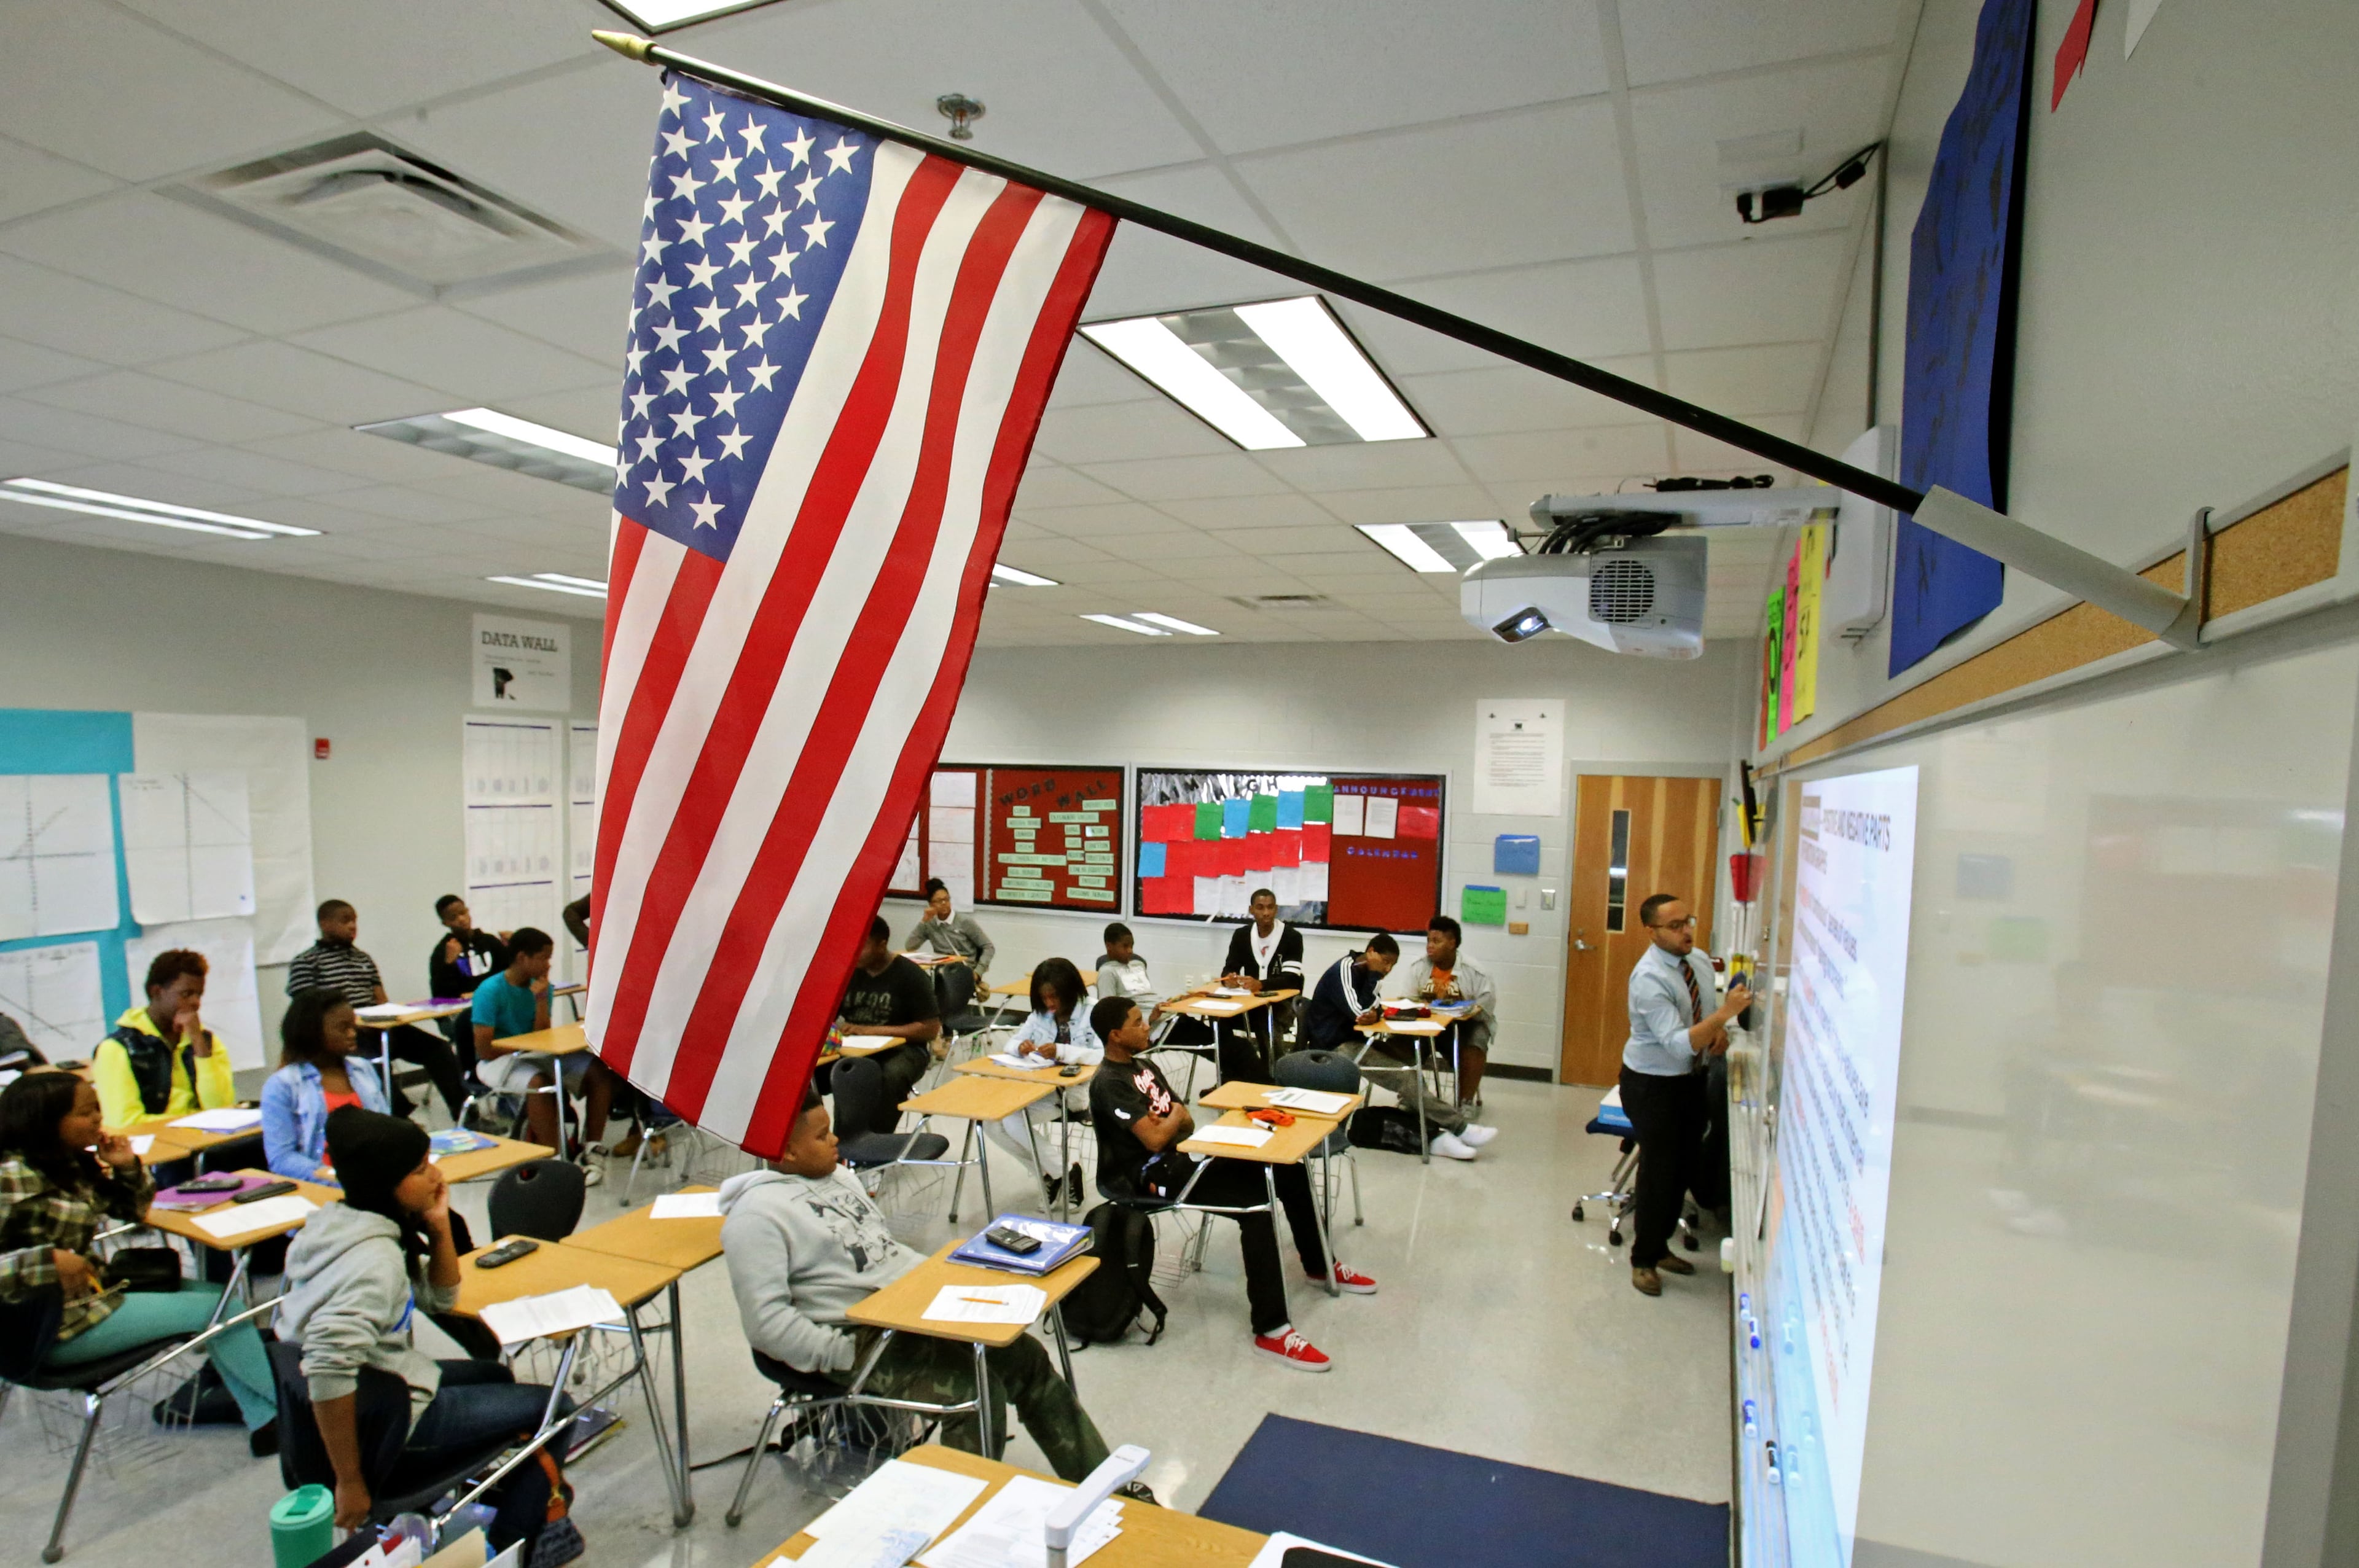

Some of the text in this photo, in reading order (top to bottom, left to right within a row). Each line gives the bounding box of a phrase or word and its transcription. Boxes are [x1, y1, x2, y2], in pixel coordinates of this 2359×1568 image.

[481, 630, 558, 652] DATA WALL
[1000, 778, 1106, 808] WORD WALL
[1869, 813, 1890, 852] PARTS
[1347, 846, 1418, 859] CALENDAR
